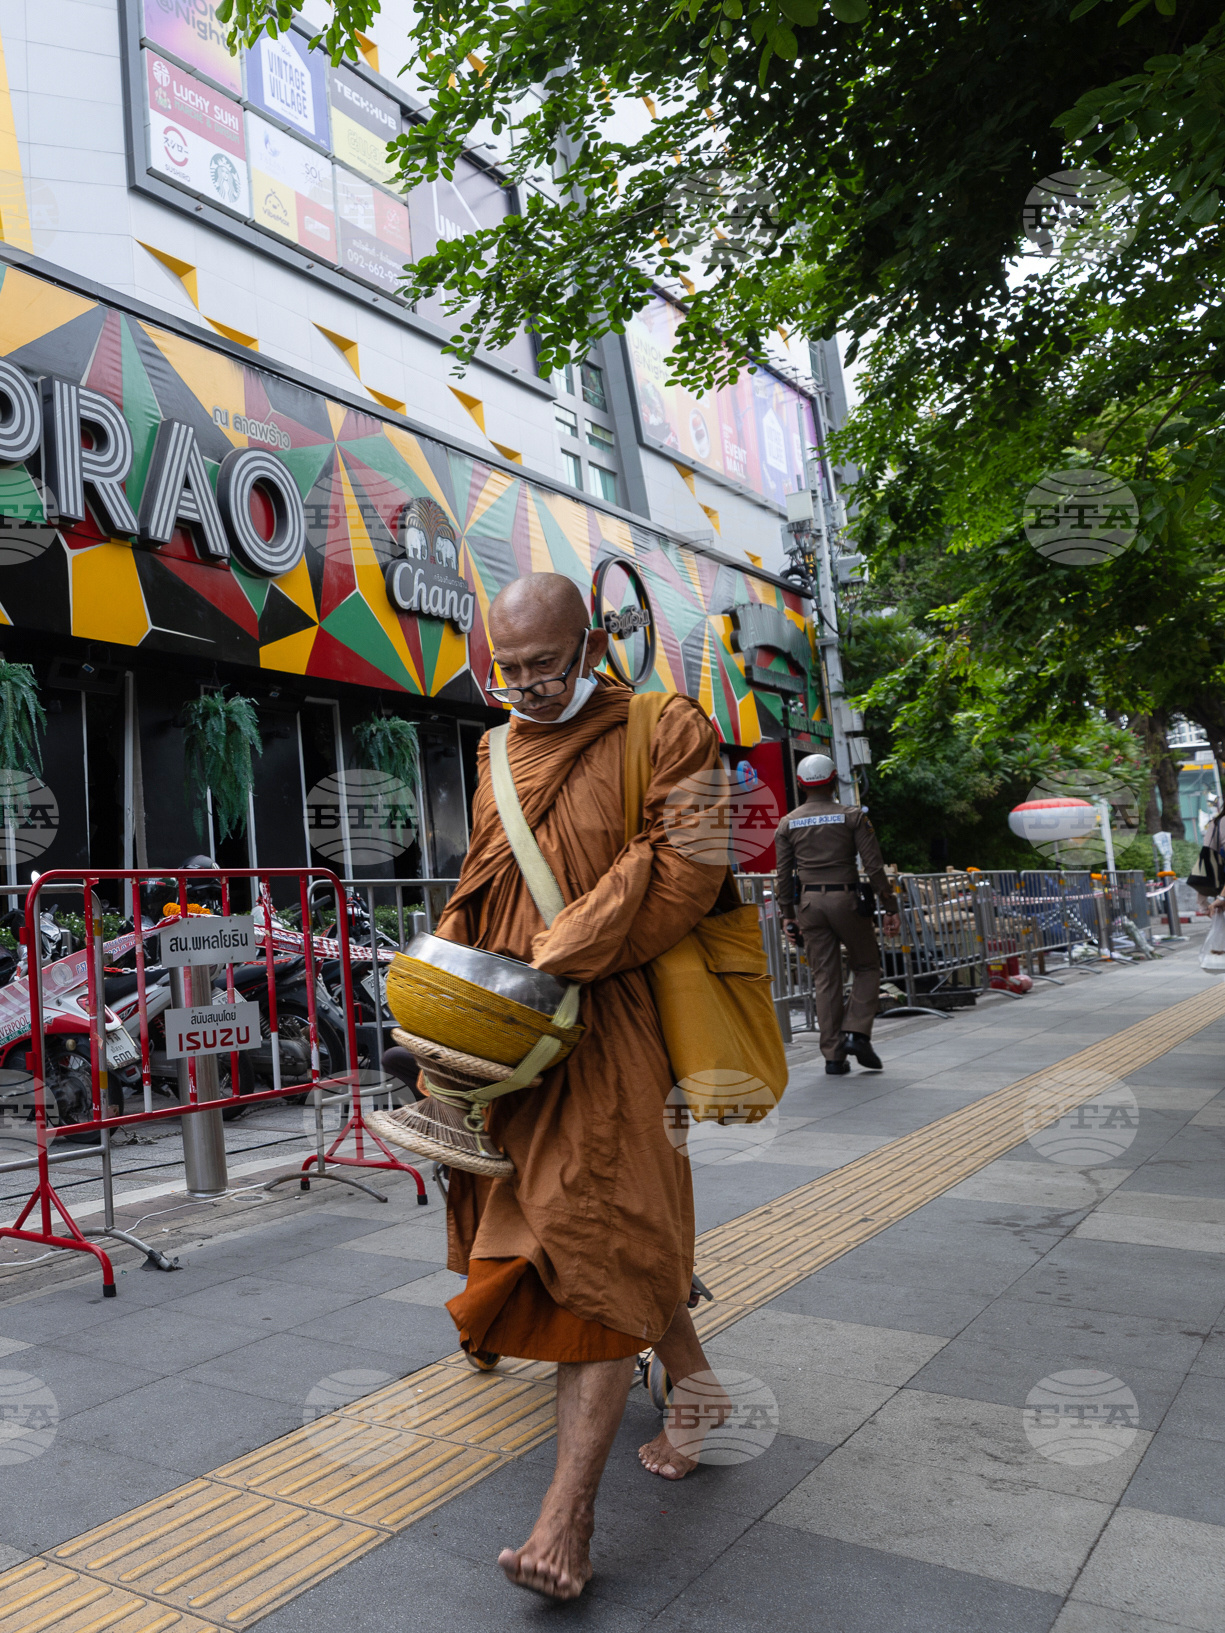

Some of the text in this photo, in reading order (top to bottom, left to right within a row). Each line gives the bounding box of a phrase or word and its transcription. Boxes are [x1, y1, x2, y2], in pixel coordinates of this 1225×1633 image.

[267, 49, 307, 95] VINTAGE
[172, 80, 239, 131] LUCKY SUKI
[269, 74, 308, 119] VILLAGE
[163, 136, 189, 155] スシロー
[164, 163, 191, 183] SUSHIRO
[305, 163, 323, 182] SOL
[213, 406, 291, 451] ณ ลาดพร้าว
[724, 440, 747, 464] EVENT
[726, 456, 746, 479] MALL
[393, 562, 474, 633] Chang
[792, 814, 841, 827] TRAFFIC POLICE
[169, 929, 249, 953] สน.พหลโยธิน
[191, 1009, 236, 1026] สนับสนุนโดย
[0, 1037, 9, 1045] WE
[9, 1031, 19, 1041] ARE
[178, 1025, 250, 1052] ISUZU
